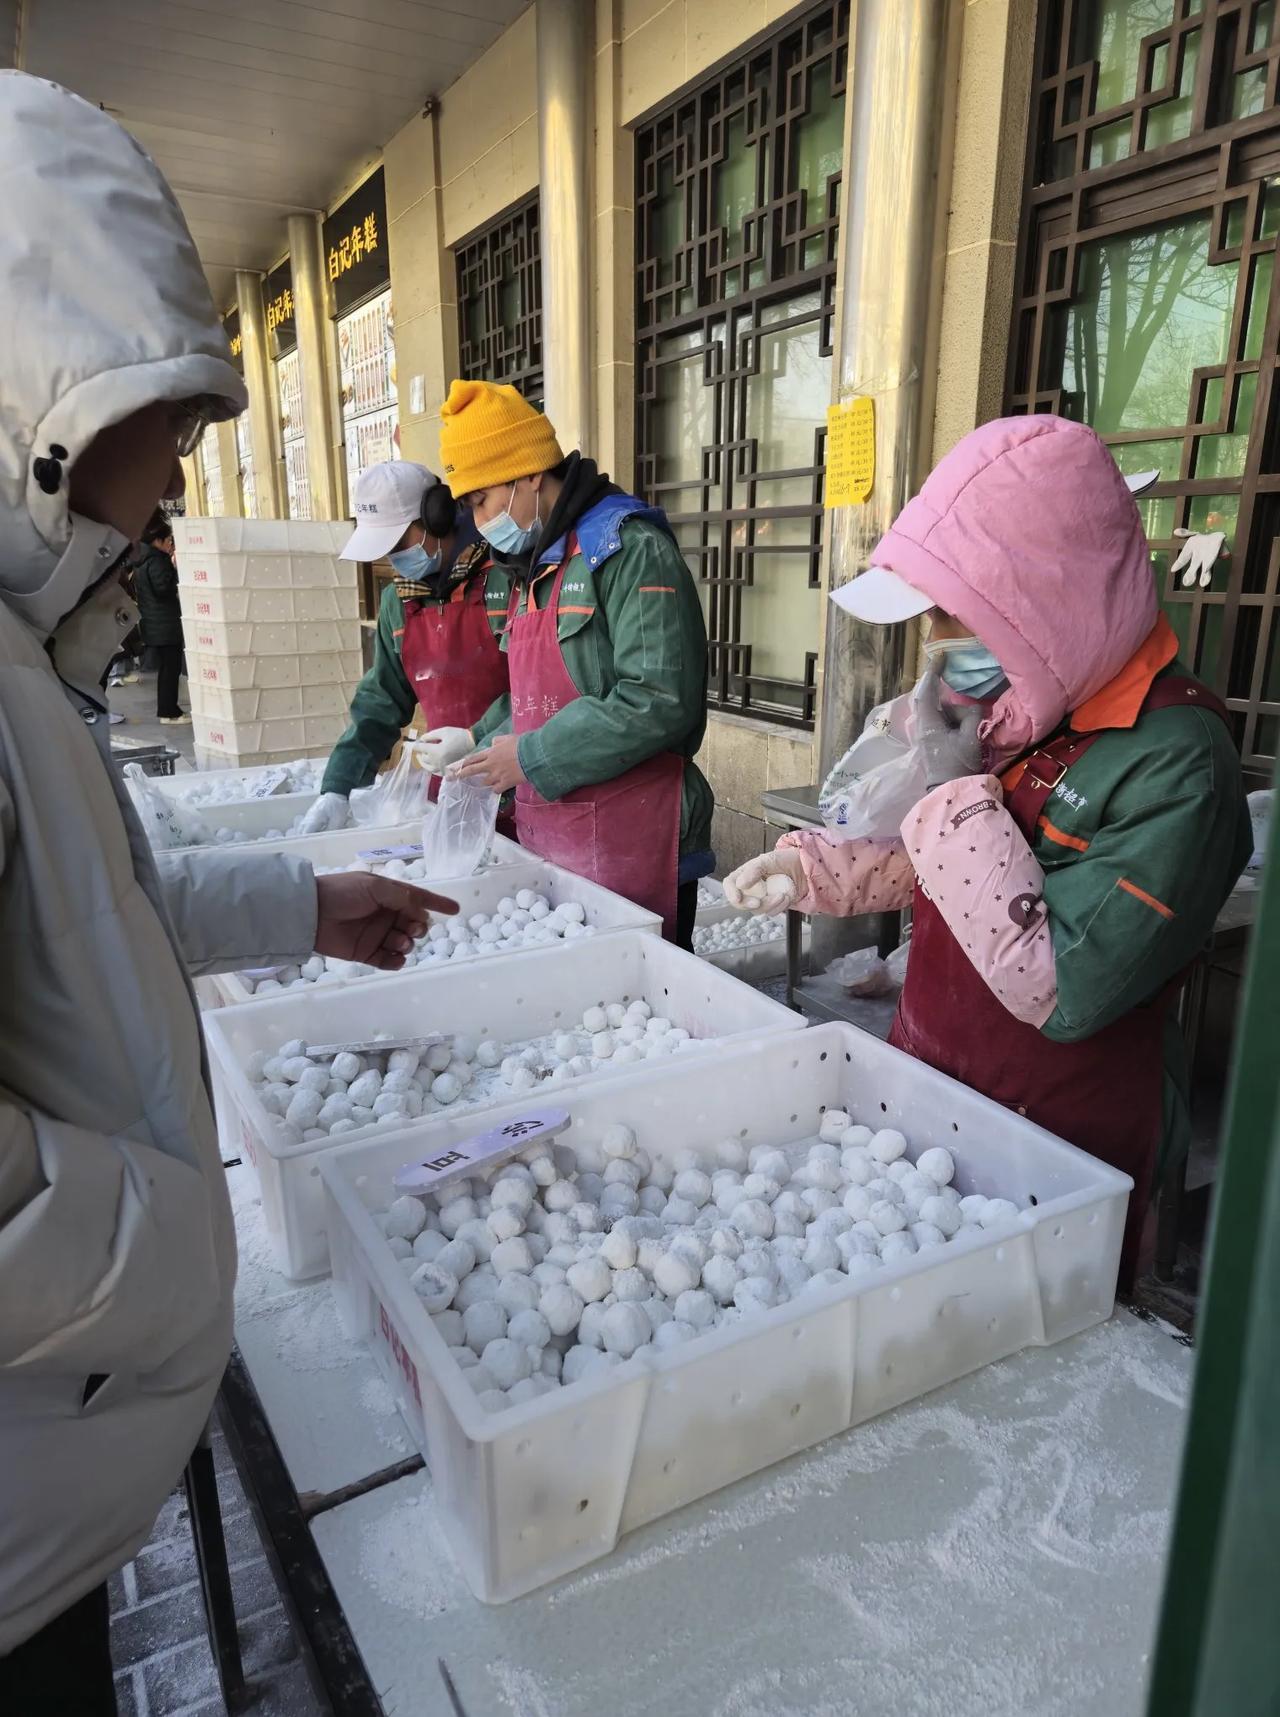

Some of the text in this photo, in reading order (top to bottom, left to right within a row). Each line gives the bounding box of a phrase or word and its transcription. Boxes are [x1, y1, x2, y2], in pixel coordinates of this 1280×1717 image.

[267, 289, 295, 333] 白记年
[959, 800, 991, 820] BROWN
[421, 1119, 545, 1172] 豆沙
